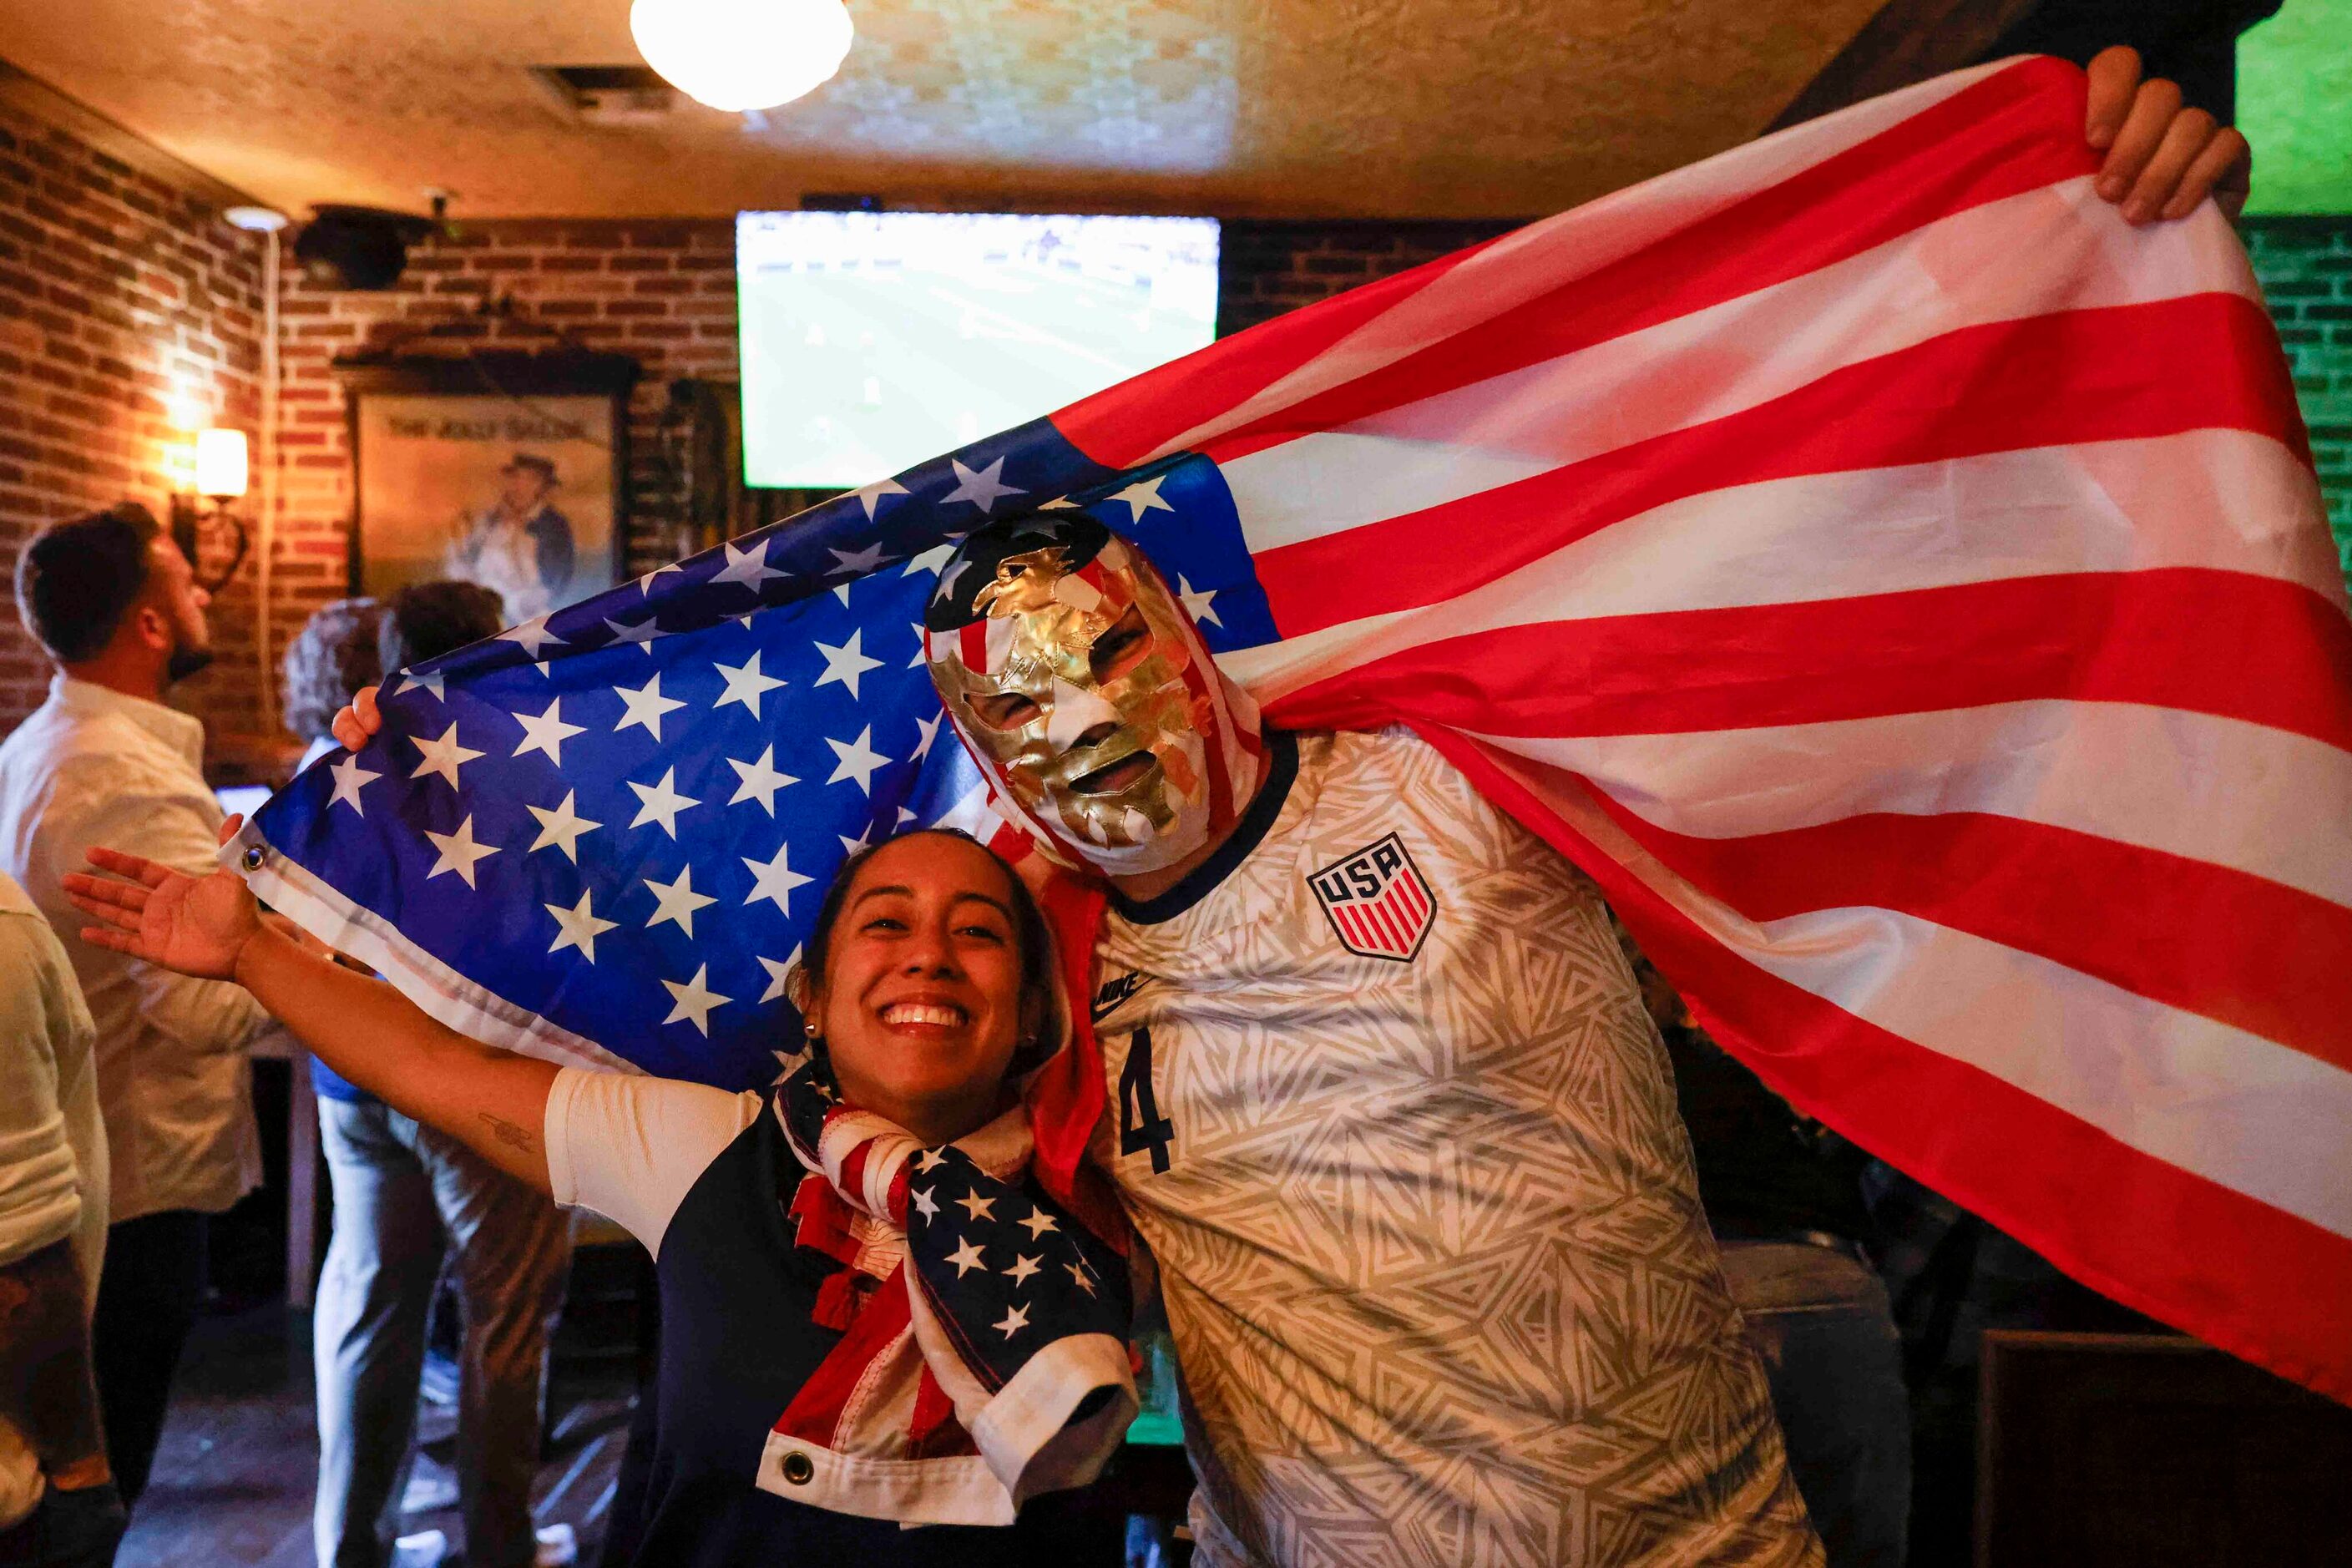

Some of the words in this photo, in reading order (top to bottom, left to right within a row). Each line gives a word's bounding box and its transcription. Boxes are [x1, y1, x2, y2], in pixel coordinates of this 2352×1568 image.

[1318, 842, 1403, 899] USA
[1095, 972, 1139, 1006] NIKE
[1119, 1026, 1175, 1175] 4
